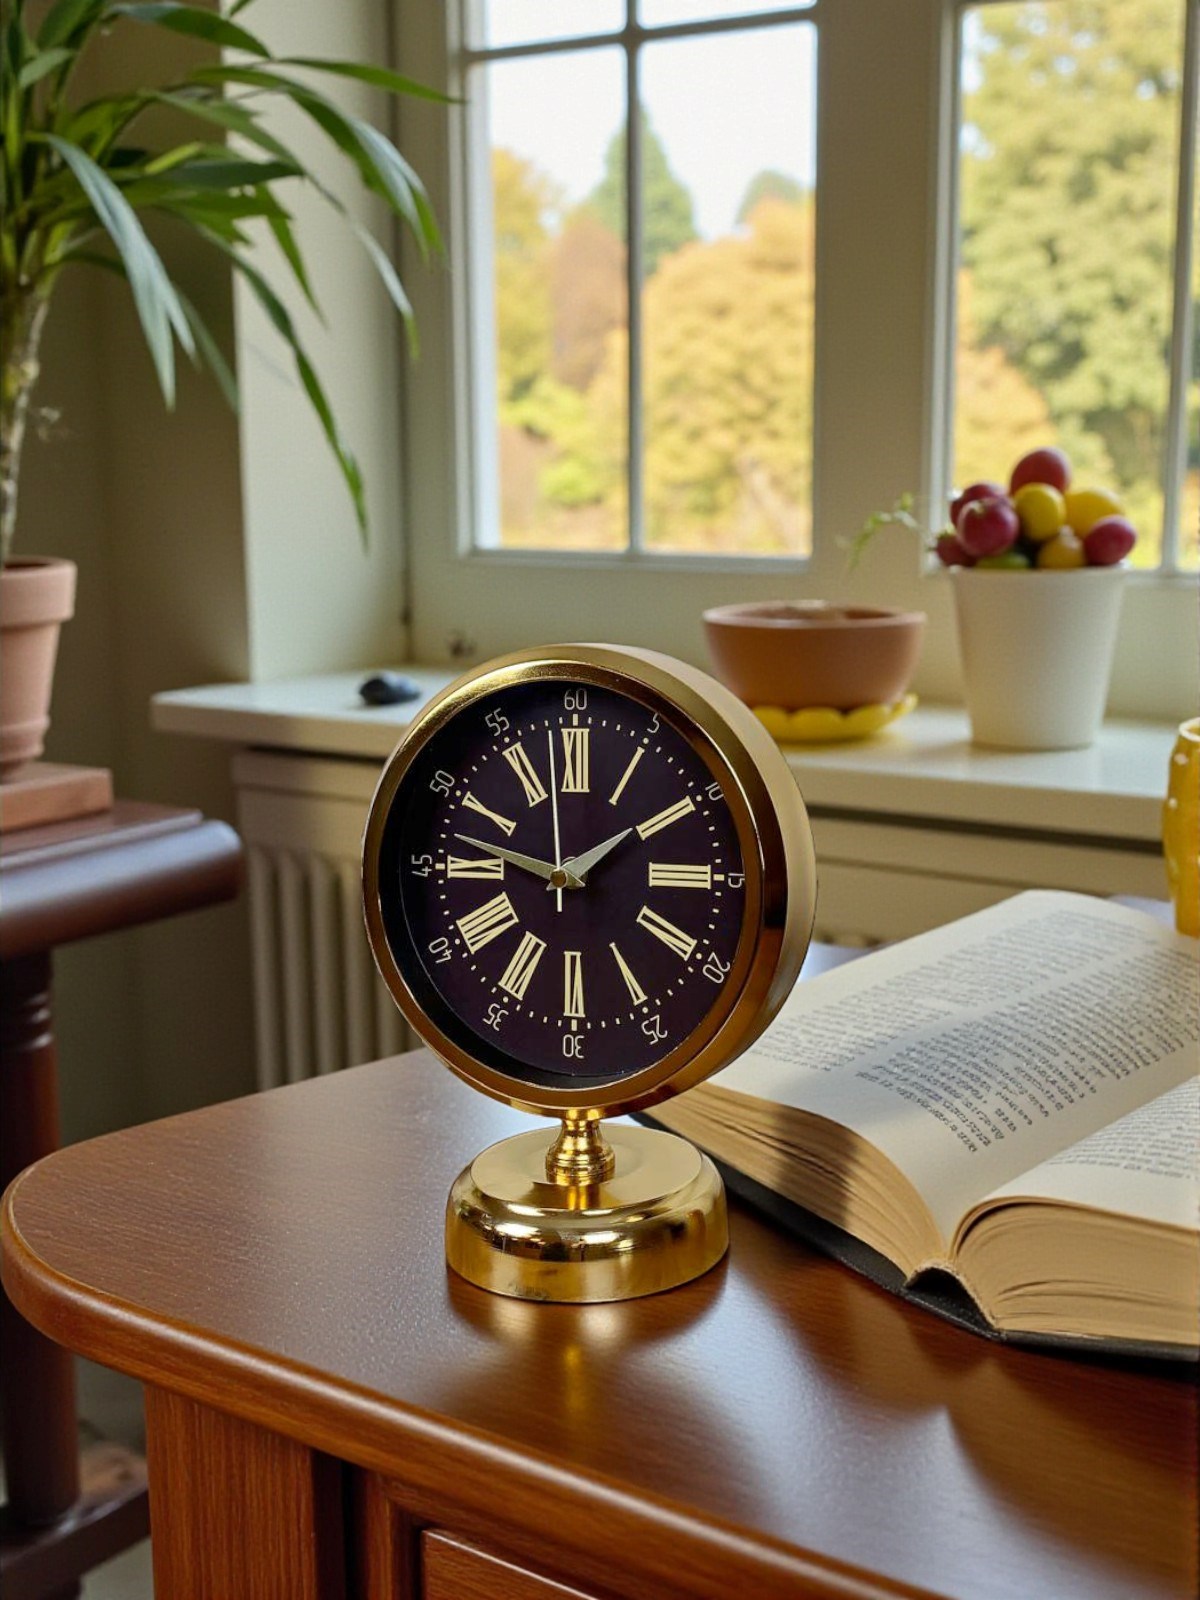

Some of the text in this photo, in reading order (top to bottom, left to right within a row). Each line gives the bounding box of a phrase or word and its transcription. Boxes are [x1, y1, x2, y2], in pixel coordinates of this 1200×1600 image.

[564, 688, 588, 711] 60
[484, 708, 510, 737] 55
[646, 712, 660, 733] 5
[502, 741, 548, 807] XI
[560, 727, 590, 793] XII
[429, 769, 455, 798] 50
[461, 791, 517, 836] X
[635, 795, 696, 840] II
[411, 853, 433, 877] 45
[447, 854, 505, 881] IX
[648, 861, 711, 890] III
[636, 904, 698, 962] IV
[428, 937, 453, 964] 40
[498, 930, 547, 1001] VII
[609, 941, 648, 1006] V
[702, 951, 731, 984] 20
[563, 950, 586, 1018] VI
[482, 1003, 510, 1032] 35
[640, 1014, 668, 1046] 25
[562, 1033, 585, 1059] 30
